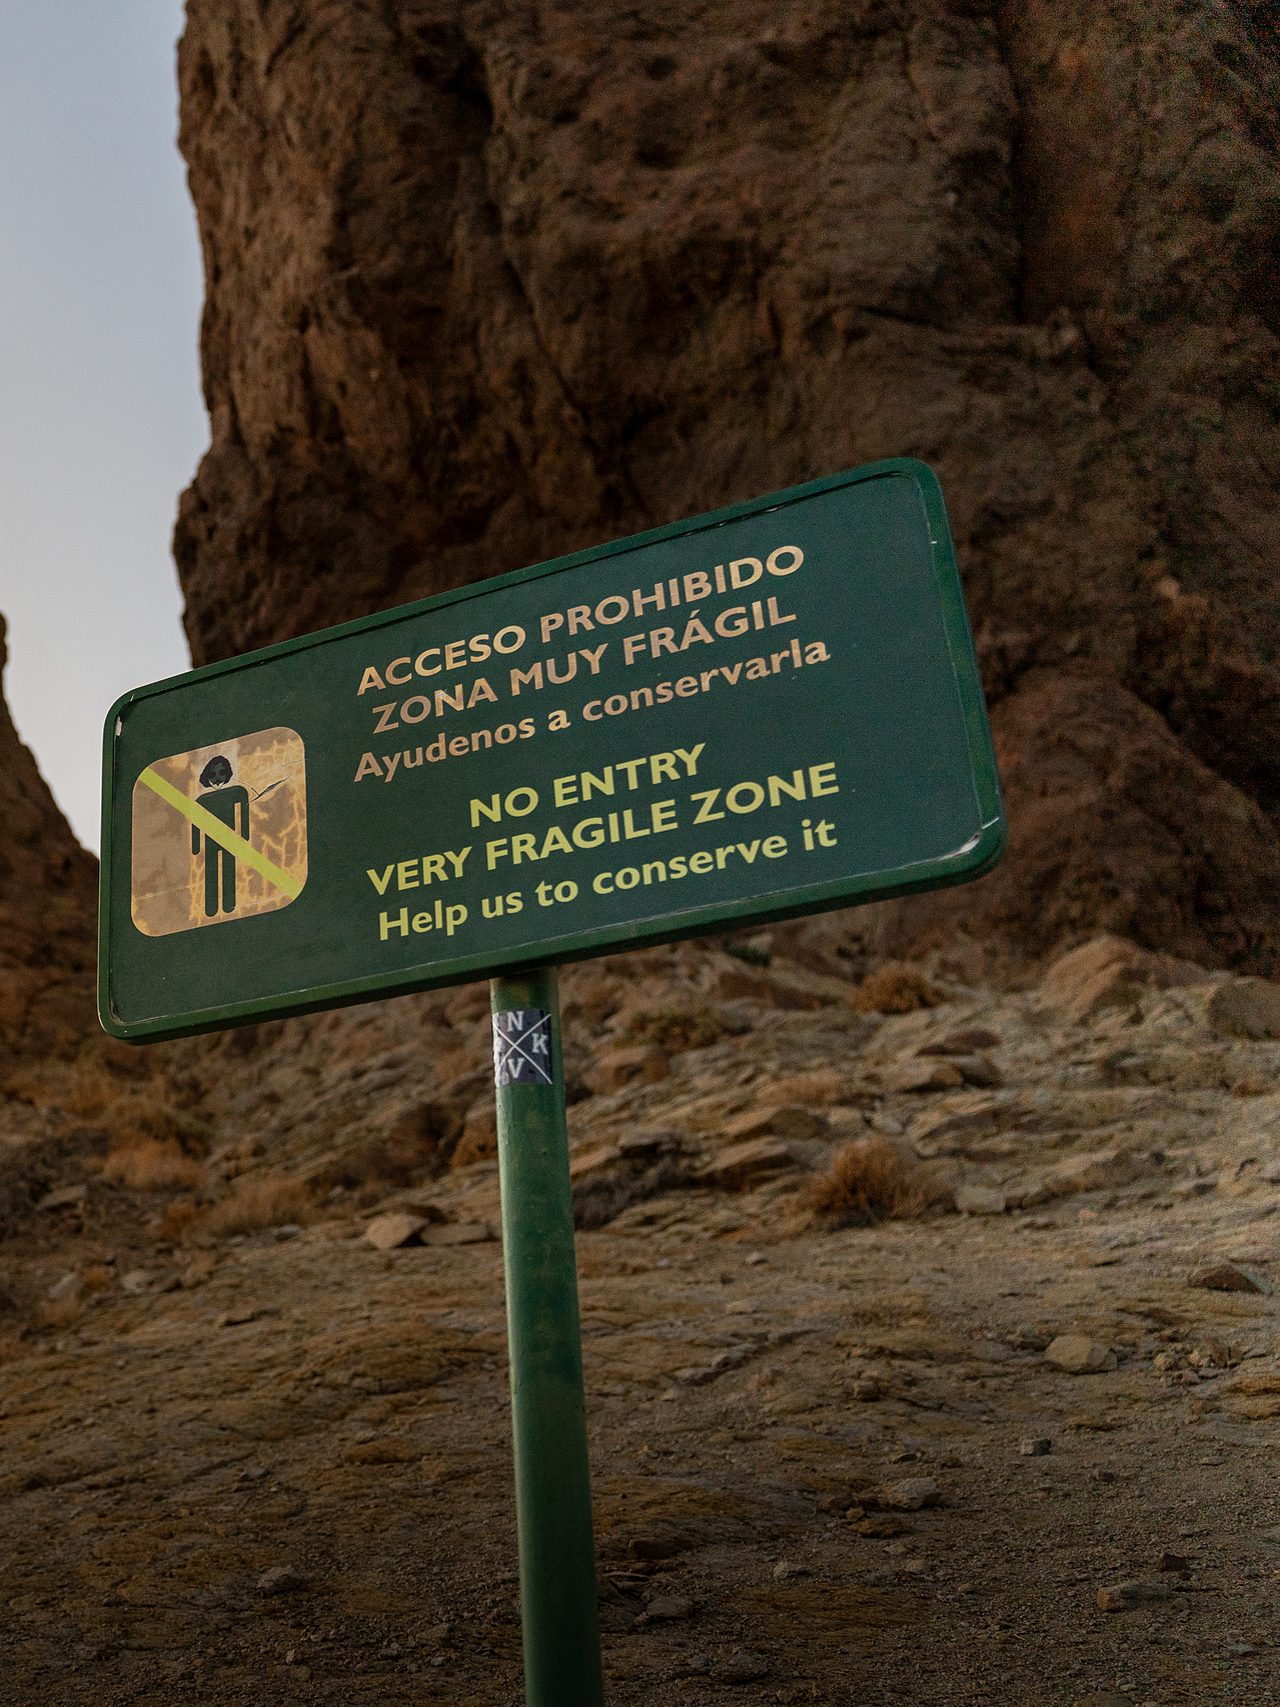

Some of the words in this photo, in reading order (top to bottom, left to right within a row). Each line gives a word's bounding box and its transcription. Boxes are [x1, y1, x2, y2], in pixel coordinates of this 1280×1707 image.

[356, 624, 527, 697] ACCESO
[540, 545, 805, 644] PROHIBIDO
[372, 677, 499, 735] ZONA
[509, 642, 609, 697] MUY
[622, 596, 797, 666] FRÁGIL
[353, 717, 536, 783] Ayudenos
[547, 709, 572, 732] a
[582, 638, 832, 722] conservarla
[366, 846, 473, 896] VERY
[485, 798, 679, 871] FRAGILE
[690, 761, 840, 825] ZONE
[469, 786, 539, 828] NO
[553, 742, 706, 808] ENTRY
[379, 899, 469, 941] Help
[481, 891, 524, 919] us
[534, 880, 579, 907] to
[592, 835, 788, 895] conserve
[801, 818, 838, 851] it
[507, 1010, 524, 1032] N
[508, 1057, 525, 1079] V
[532, 1033, 549, 1055] K
